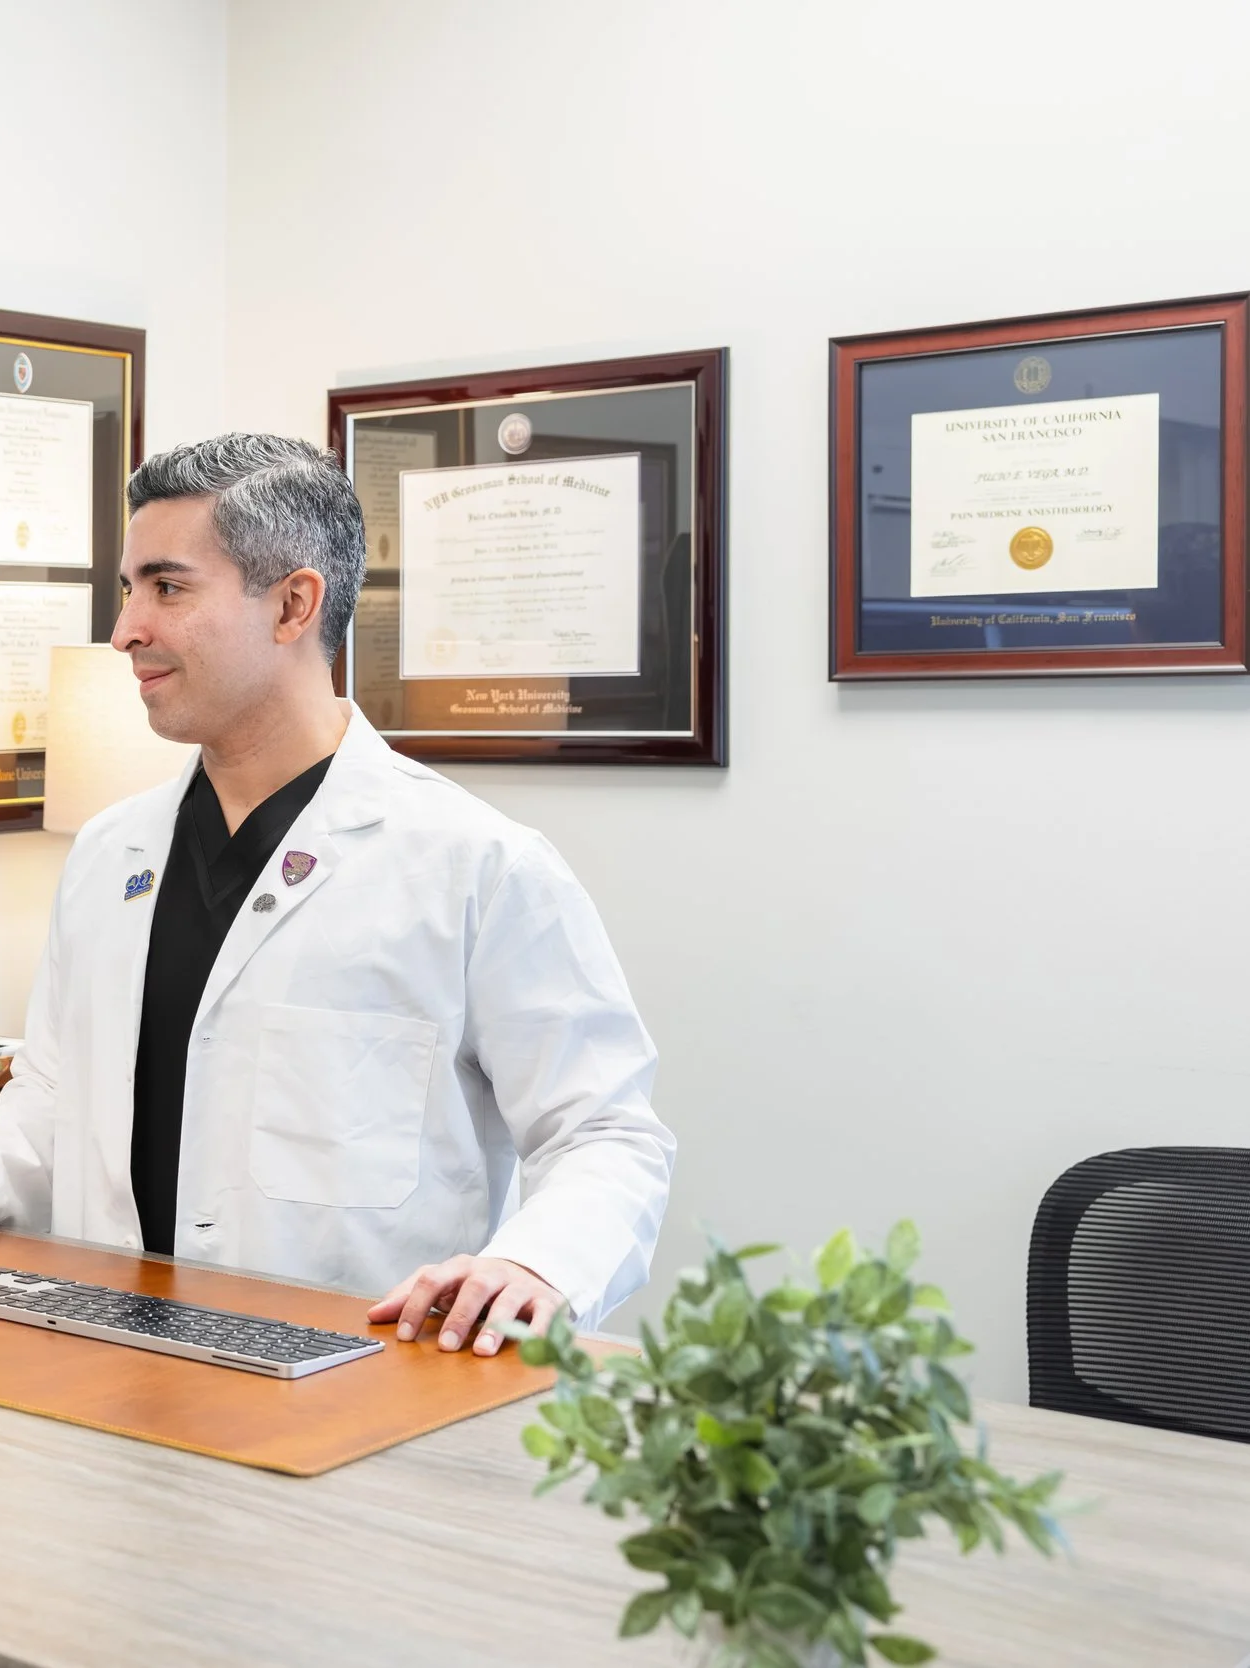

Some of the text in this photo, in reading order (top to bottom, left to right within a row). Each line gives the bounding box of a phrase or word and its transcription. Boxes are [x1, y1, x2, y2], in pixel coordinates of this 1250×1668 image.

[945, 410, 1122, 432] UNIVERSITY OF CALIFORNIA
[982, 427, 1082, 443] SAN FRANCISCO
[451, 479, 504, 499] Grossman
[507, 473, 545, 486] School
[547, 474, 560, 486] of
[562, 475, 611, 498] Medicine
[976, 509, 1023, 519] MEDICINE
[1027, 503, 1115, 517] ANESTHESIOLOGY
[930, 615, 983, 628] University
[985, 614, 995, 625] of
[1056, 612, 1080, 624] San
[1081, 611, 1136, 625] Francisco
[465, 688, 570, 703] New York University
[450, 702, 583, 715] Grossman School of Medicine
